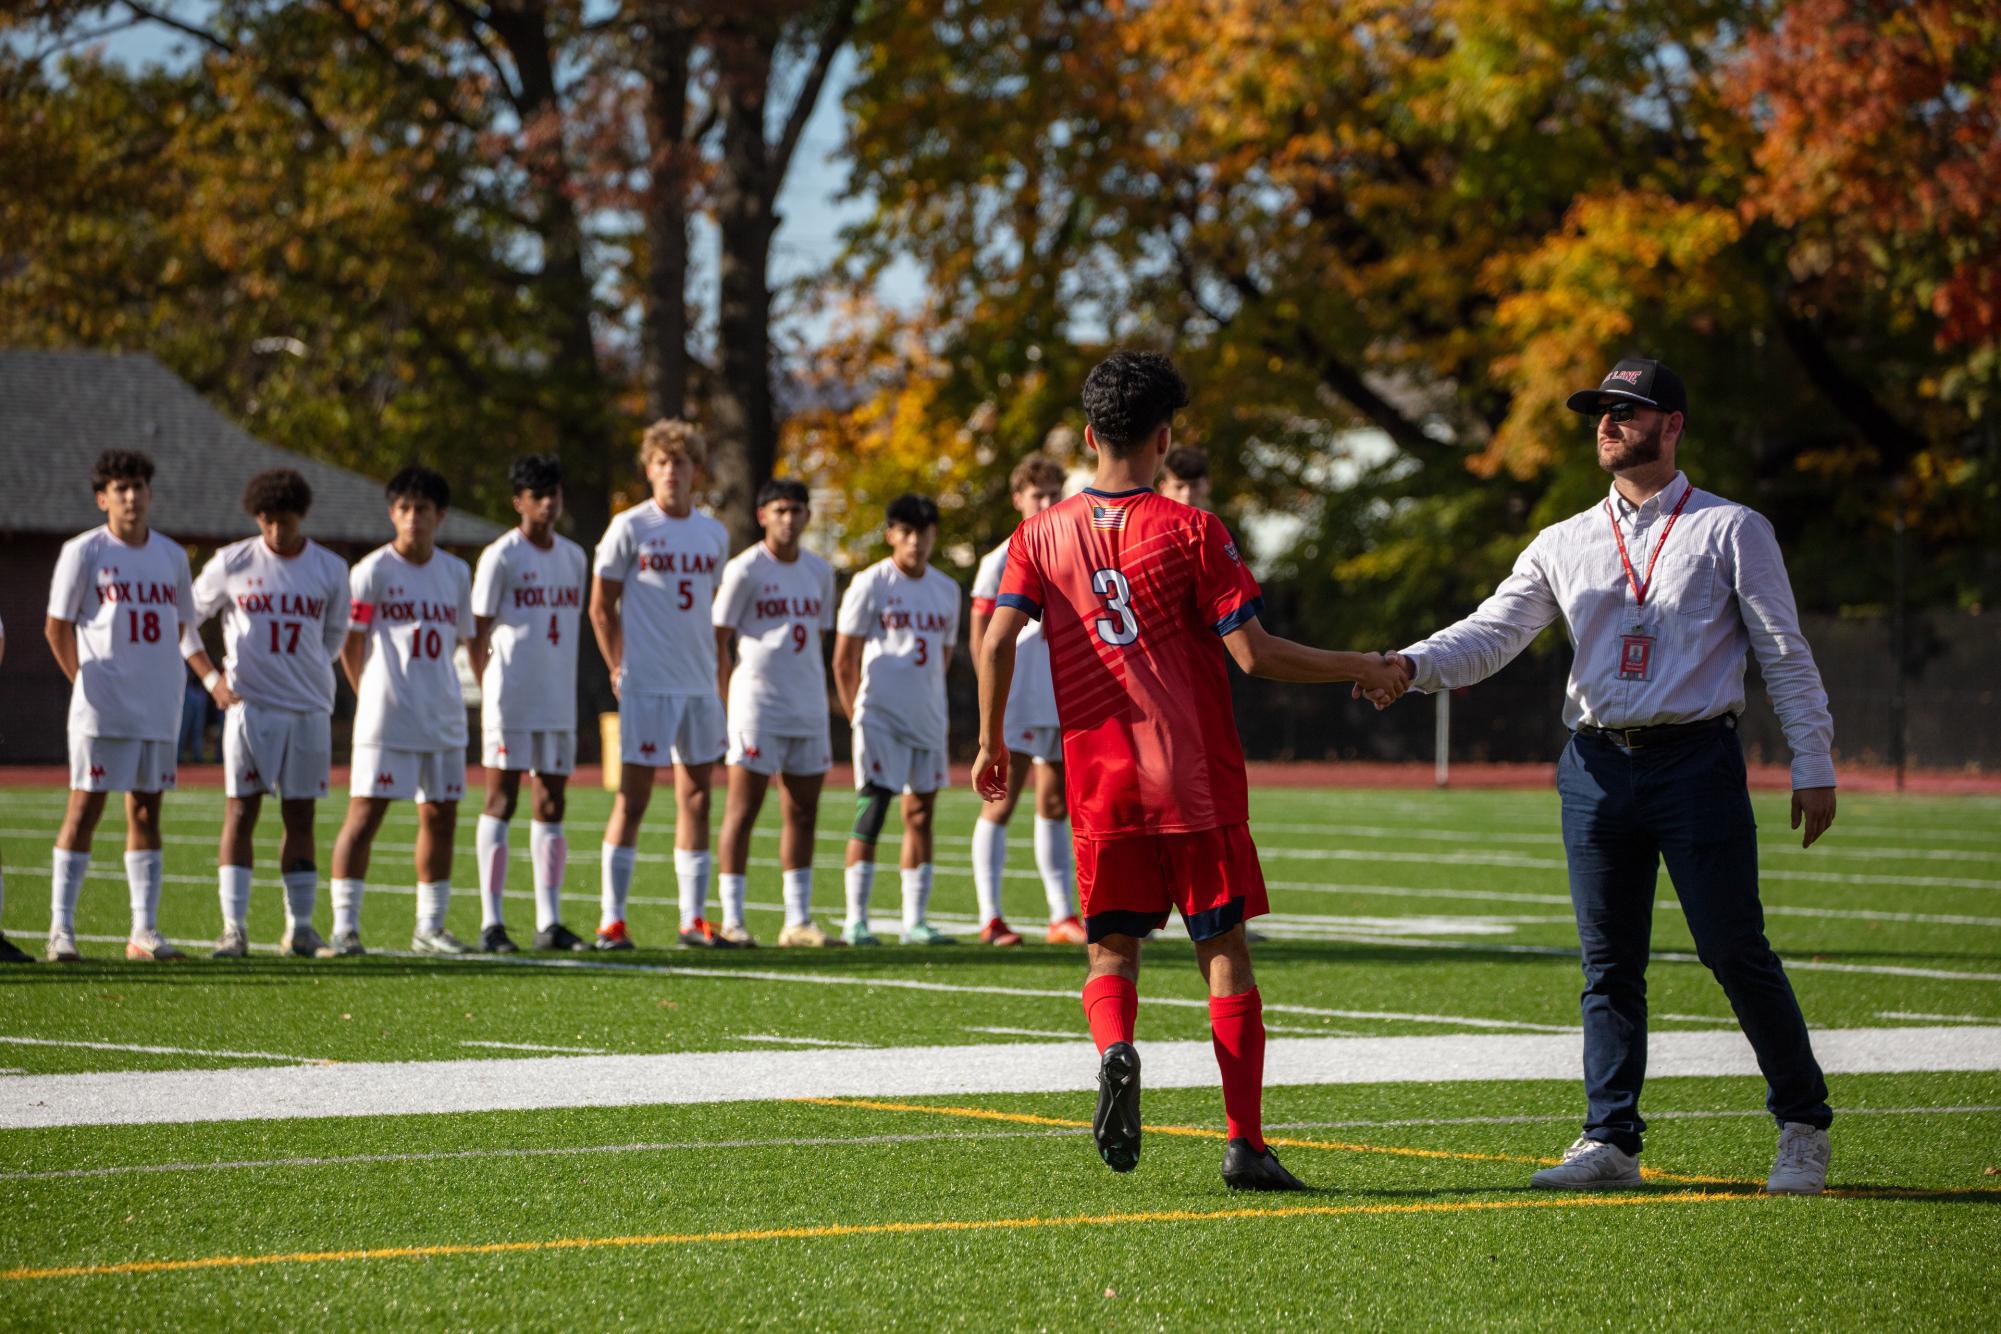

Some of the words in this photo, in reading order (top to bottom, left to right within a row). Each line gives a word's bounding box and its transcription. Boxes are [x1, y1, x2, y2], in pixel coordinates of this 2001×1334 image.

[639, 552, 676, 573] FOX
[681, 553, 717, 573] LAN
[95, 582, 132, 605] FOX
[237, 592, 273, 614] FOX
[514, 587, 546, 609] FOX
[677, 579, 694, 611] 5
[755, 597, 790, 619] FOX
[792, 598, 822, 618] LAN
[1092, 567, 1139, 646] 3
[381, 602, 416, 621] FOX
[879, 611, 914, 630] FOX
[915, 611, 947, 632] LAN
[129, 610, 161, 644] 18
[269, 620, 302, 655] 17
[547, 613, 561, 647] 4
[792, 623, 808, 655] 9
[412, 627, 442, 661] 10
[913, 637, 928, 667] 3
